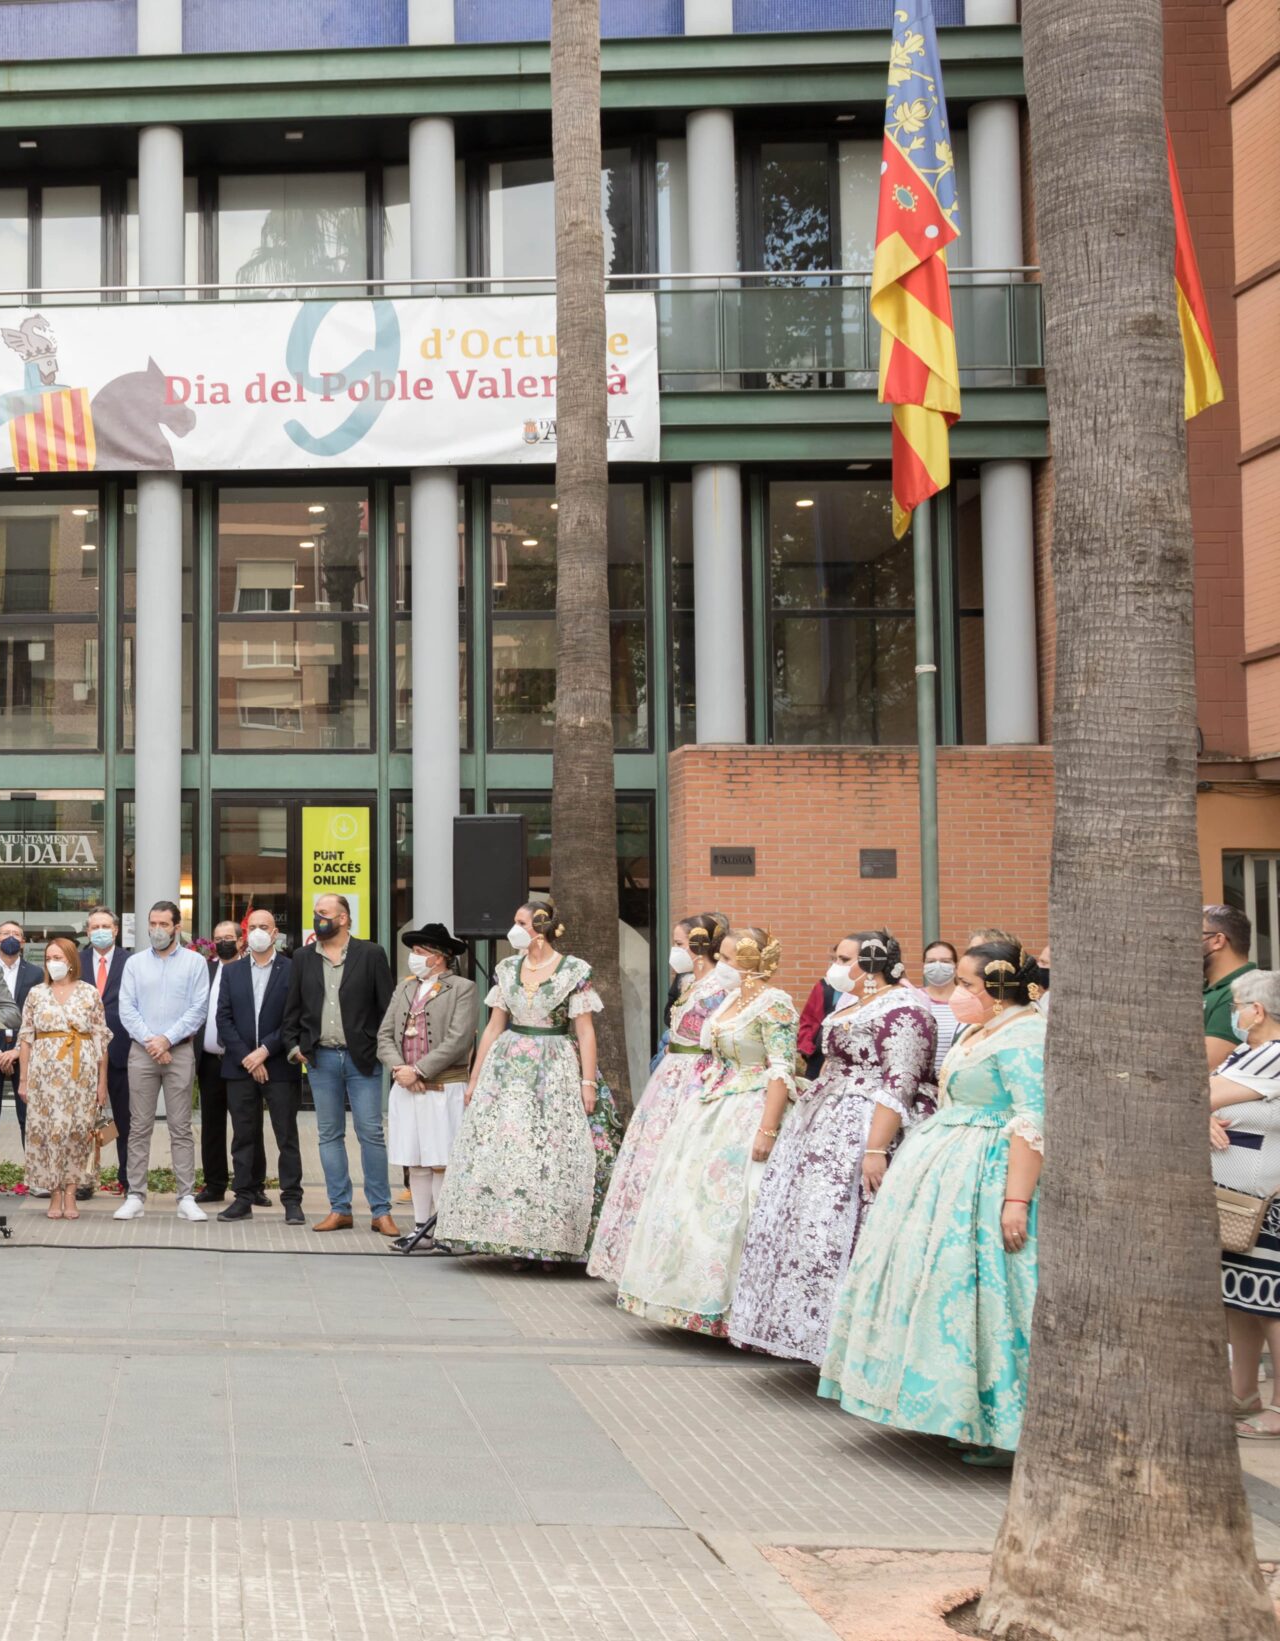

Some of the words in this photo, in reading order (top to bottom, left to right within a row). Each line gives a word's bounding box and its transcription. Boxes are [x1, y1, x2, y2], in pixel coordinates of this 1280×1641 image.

[285, 299, 401, 457] 9
[420, 328, 629, 360] d'Octue
[163, 374, 231, 406] Dia
[244, 372, 307, 403] del
[320, 370, 434, 402] Poble
[446, 364, 629, 400] Valenà
[313, 851, 345, 861] PUNT
[313, 860, 361, 873] D'ACCÉS
[313, 875, 356, 885] ONLINE
